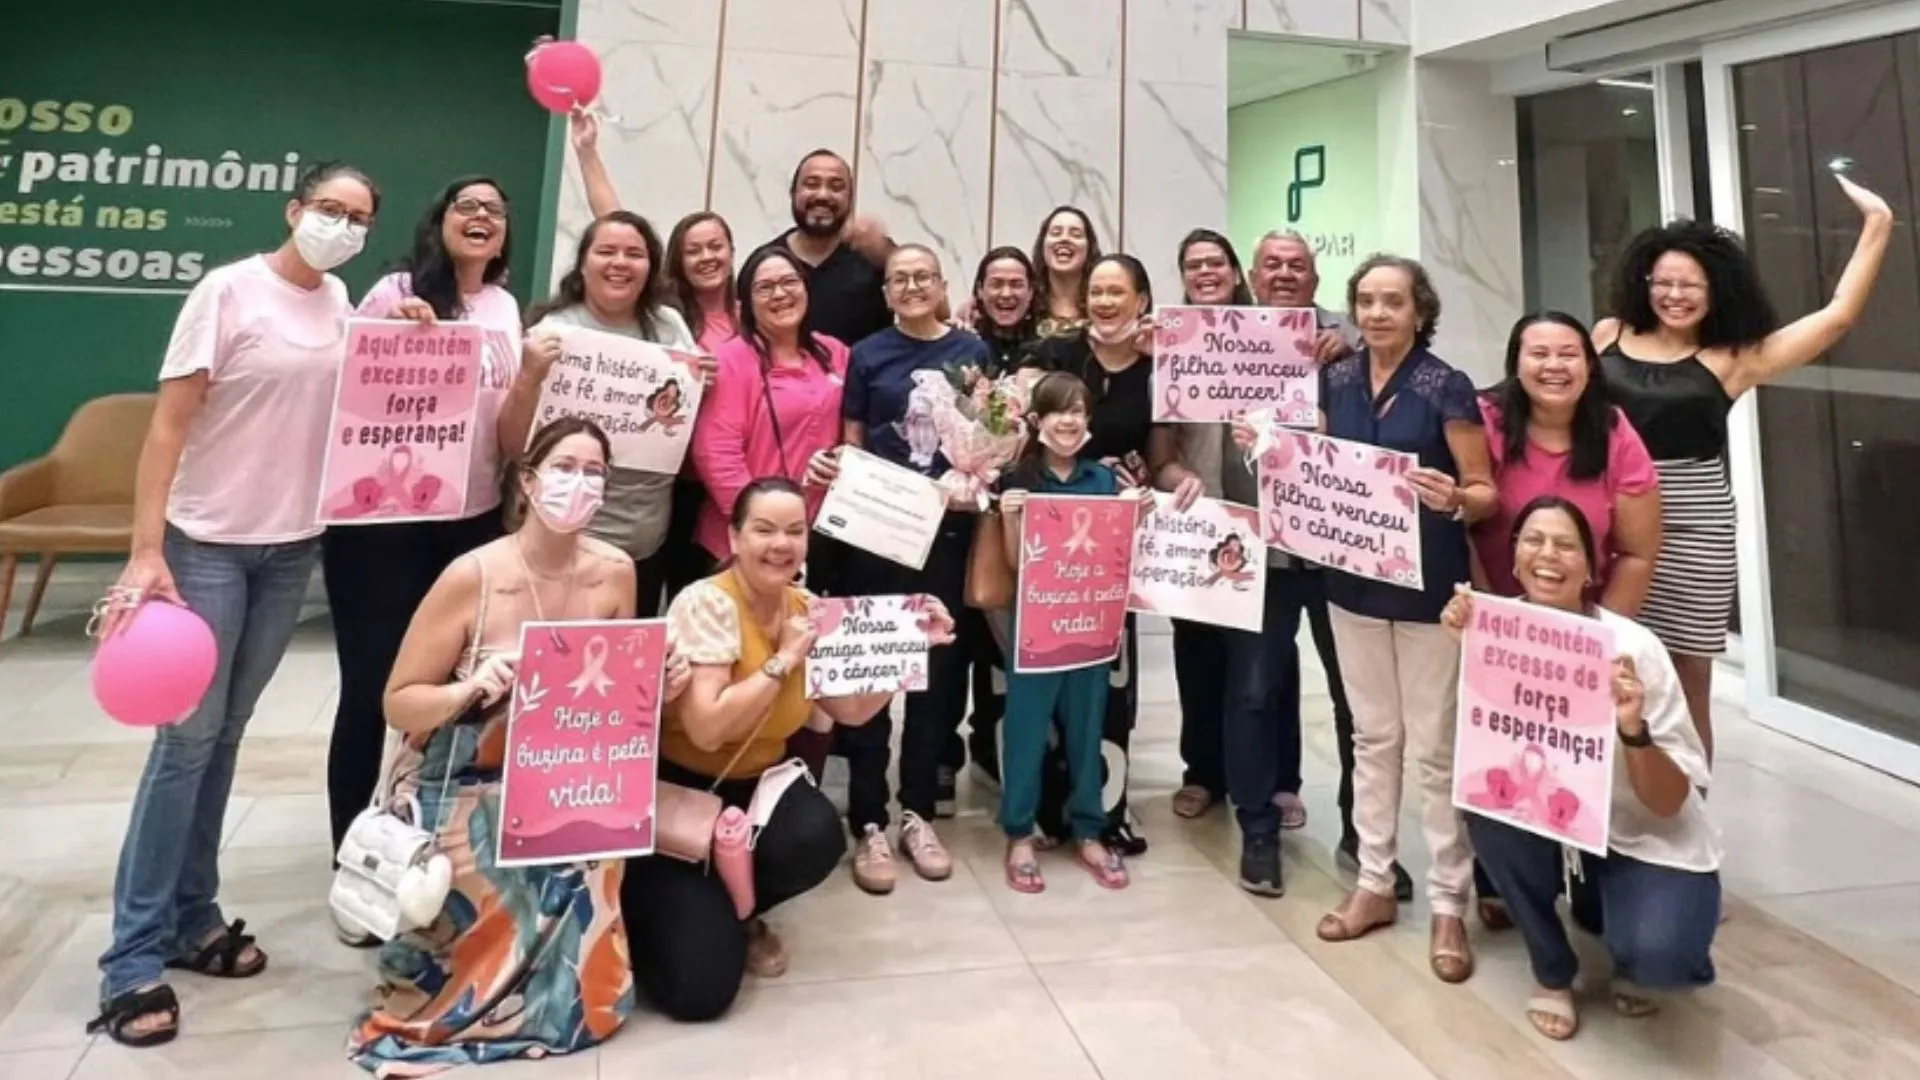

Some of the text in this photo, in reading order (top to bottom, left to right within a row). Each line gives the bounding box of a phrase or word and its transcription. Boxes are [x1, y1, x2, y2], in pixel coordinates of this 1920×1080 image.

[0, 97, 133, 136] osso
[18, 144, 299, 193] patrimôni
[0, 194, 168, 231] está nas
[1313, 232, 1354, 257] PAR
[0, 244, 204, 281] essoas
[356, 329, 472, 360] Aqui contém
[1203, 332, 1275, 354] Nossa
[360, 365, 440, 386] excesso
[444, 362, 467, 385] de
[596, 351, 658, 383] história
[1170, 353, 1308, 383] filha venceu
[551, 373, 573, 399] de
[603, 387, 644, 406] amor
[1188, 380, 1286, 401] o câncer!
[385, 393, 438, 421] força
[544, 405, 555, 420] e
[341, 421, 467, 450] e esperança!
[1300, 461, 1373, 498] Nossa
[1273, 478, 1410, 533] filha venceu
[1289, 515, 1387, 557] o câncer!
[1165, 542, 1207, 561] amor
[1053, 560, 1106, 584] Hoje a
[1133, 564, 1206, 589] uperação
[841, 616, 899, 637] Nossa
[1051, 612, 1104, 634] vida!
[1478, 610, 1604, 660] Aqui contém
[810, 640, 929, 664] amiga venceu
[828, 658, 907, 683] o câncer!
[1484, 644, 1600, 692] excesso de
[1514, 682, 1571, 723] força
[555, 706, 624, 734] Hoje a
[1471, 707, 1605, 766] e esperança!
[592, 740, 603, 763] é
[550, 773, 622, 807] vida!
